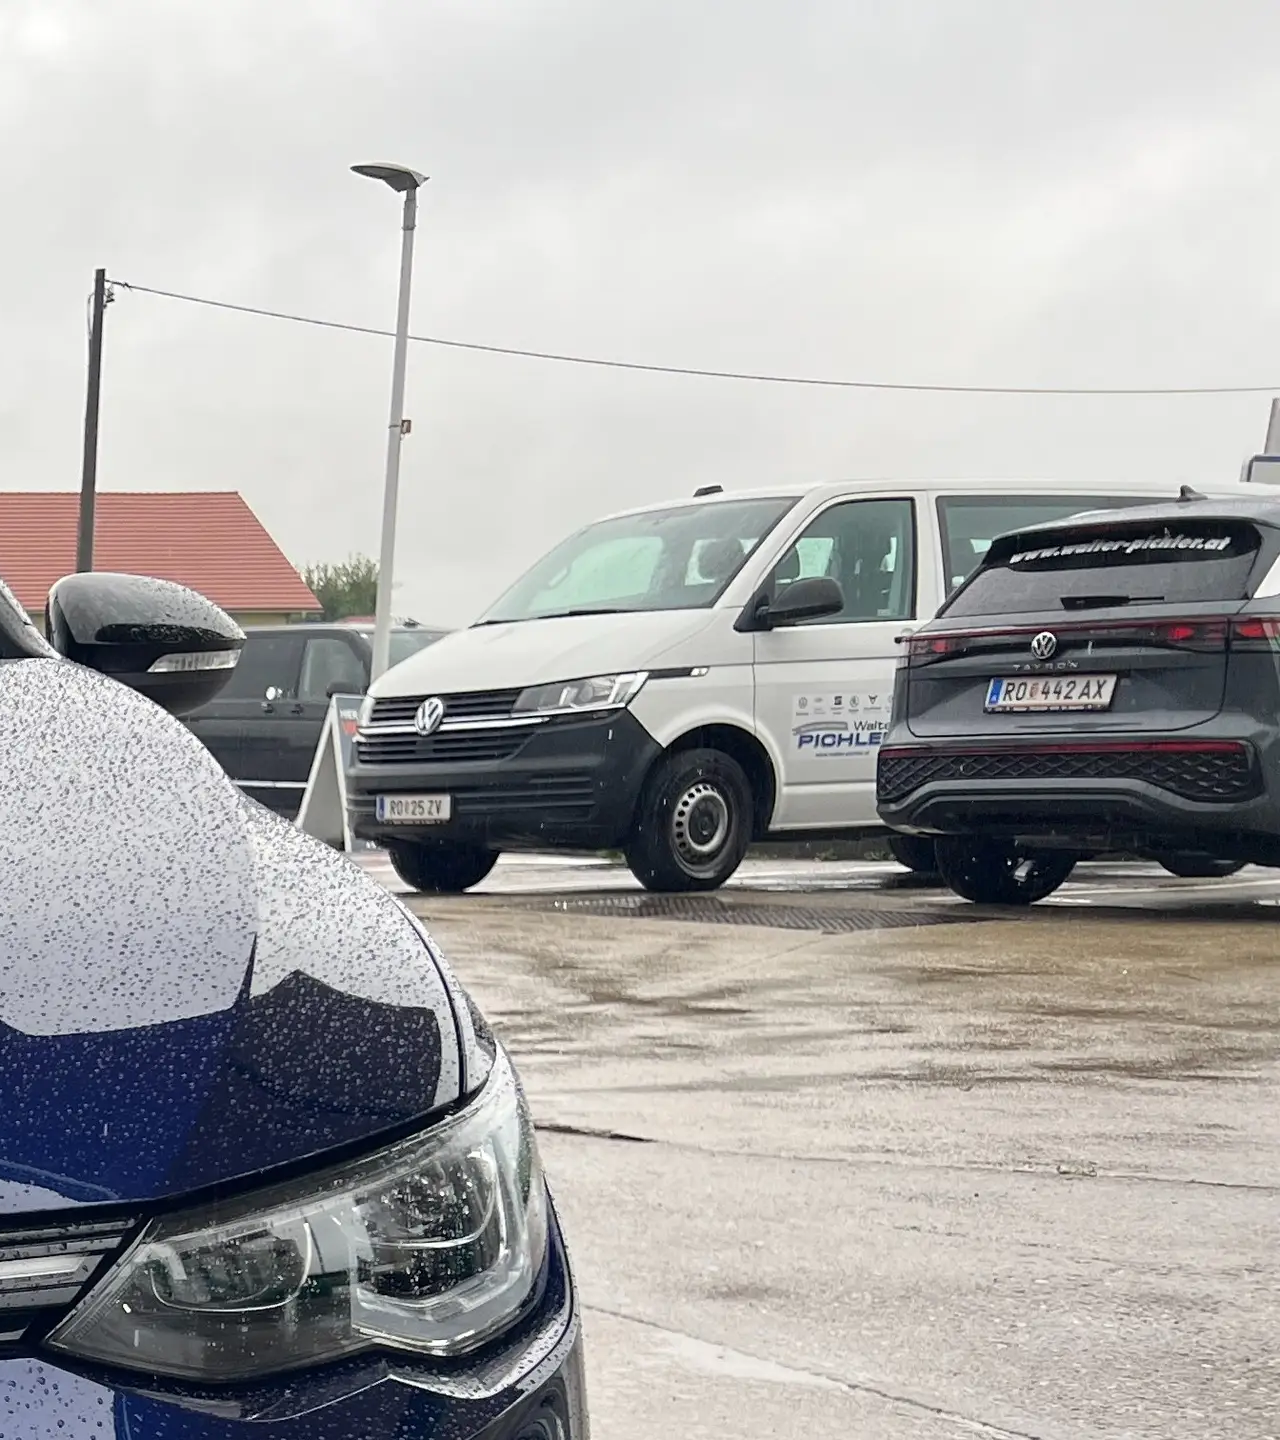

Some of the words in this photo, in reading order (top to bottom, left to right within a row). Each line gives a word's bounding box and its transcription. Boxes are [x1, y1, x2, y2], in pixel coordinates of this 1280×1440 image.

[1009, 535, 1231, 564] www.walter-pichler.at
[1003, 682, 1028, 701] RO
[1042, 680, 1077, 700] 442
[1078, 679, 1107, 699] AX
[798, 732, 888, 749] PICHLE
